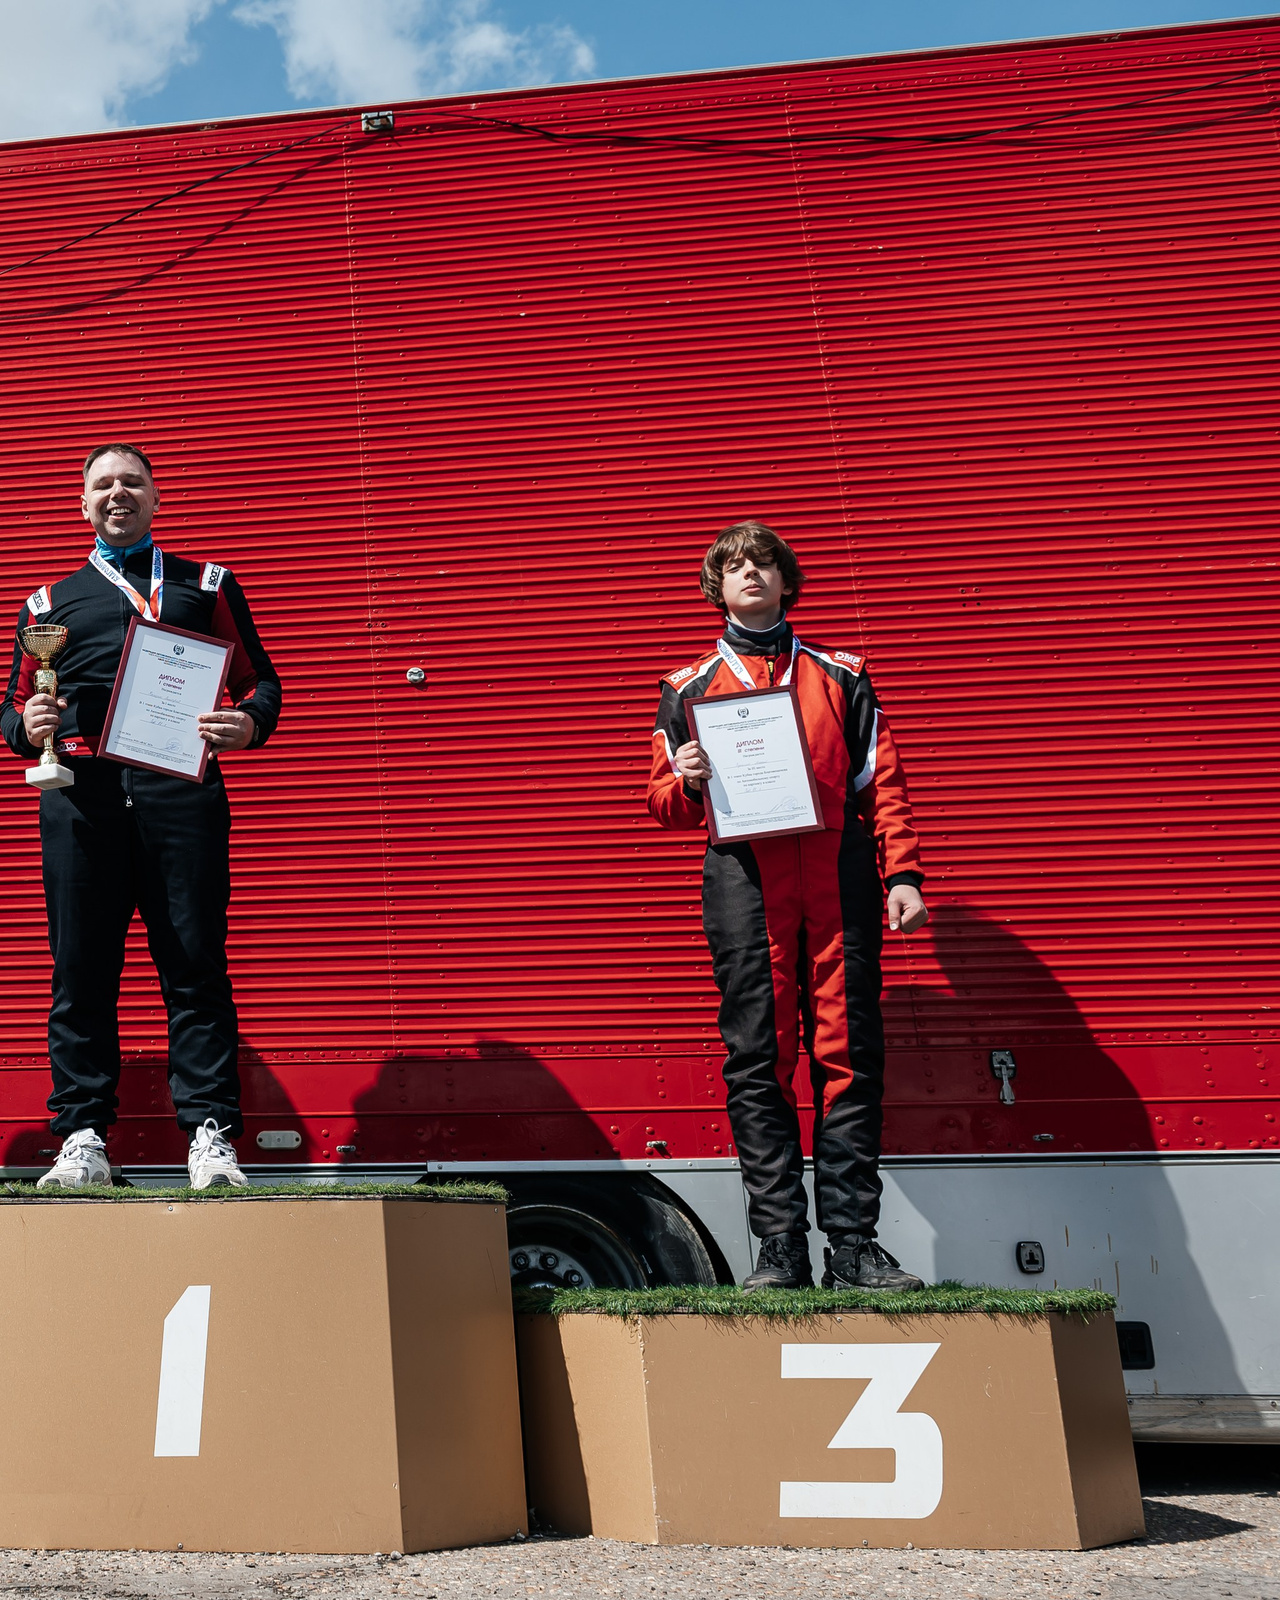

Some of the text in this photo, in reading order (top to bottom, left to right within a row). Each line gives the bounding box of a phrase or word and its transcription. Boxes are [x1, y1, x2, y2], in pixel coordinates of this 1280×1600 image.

[834, 650, 862, 666] OMP
[157, 673, 185, 685] ДИПЛОМ
[669, 666, 696, 684] OMP
[736, 738, 764, 748] ДИПЛОМ
[154, 1286, 210, 1456] 1
[780, 1343, 942, 1518] 3
